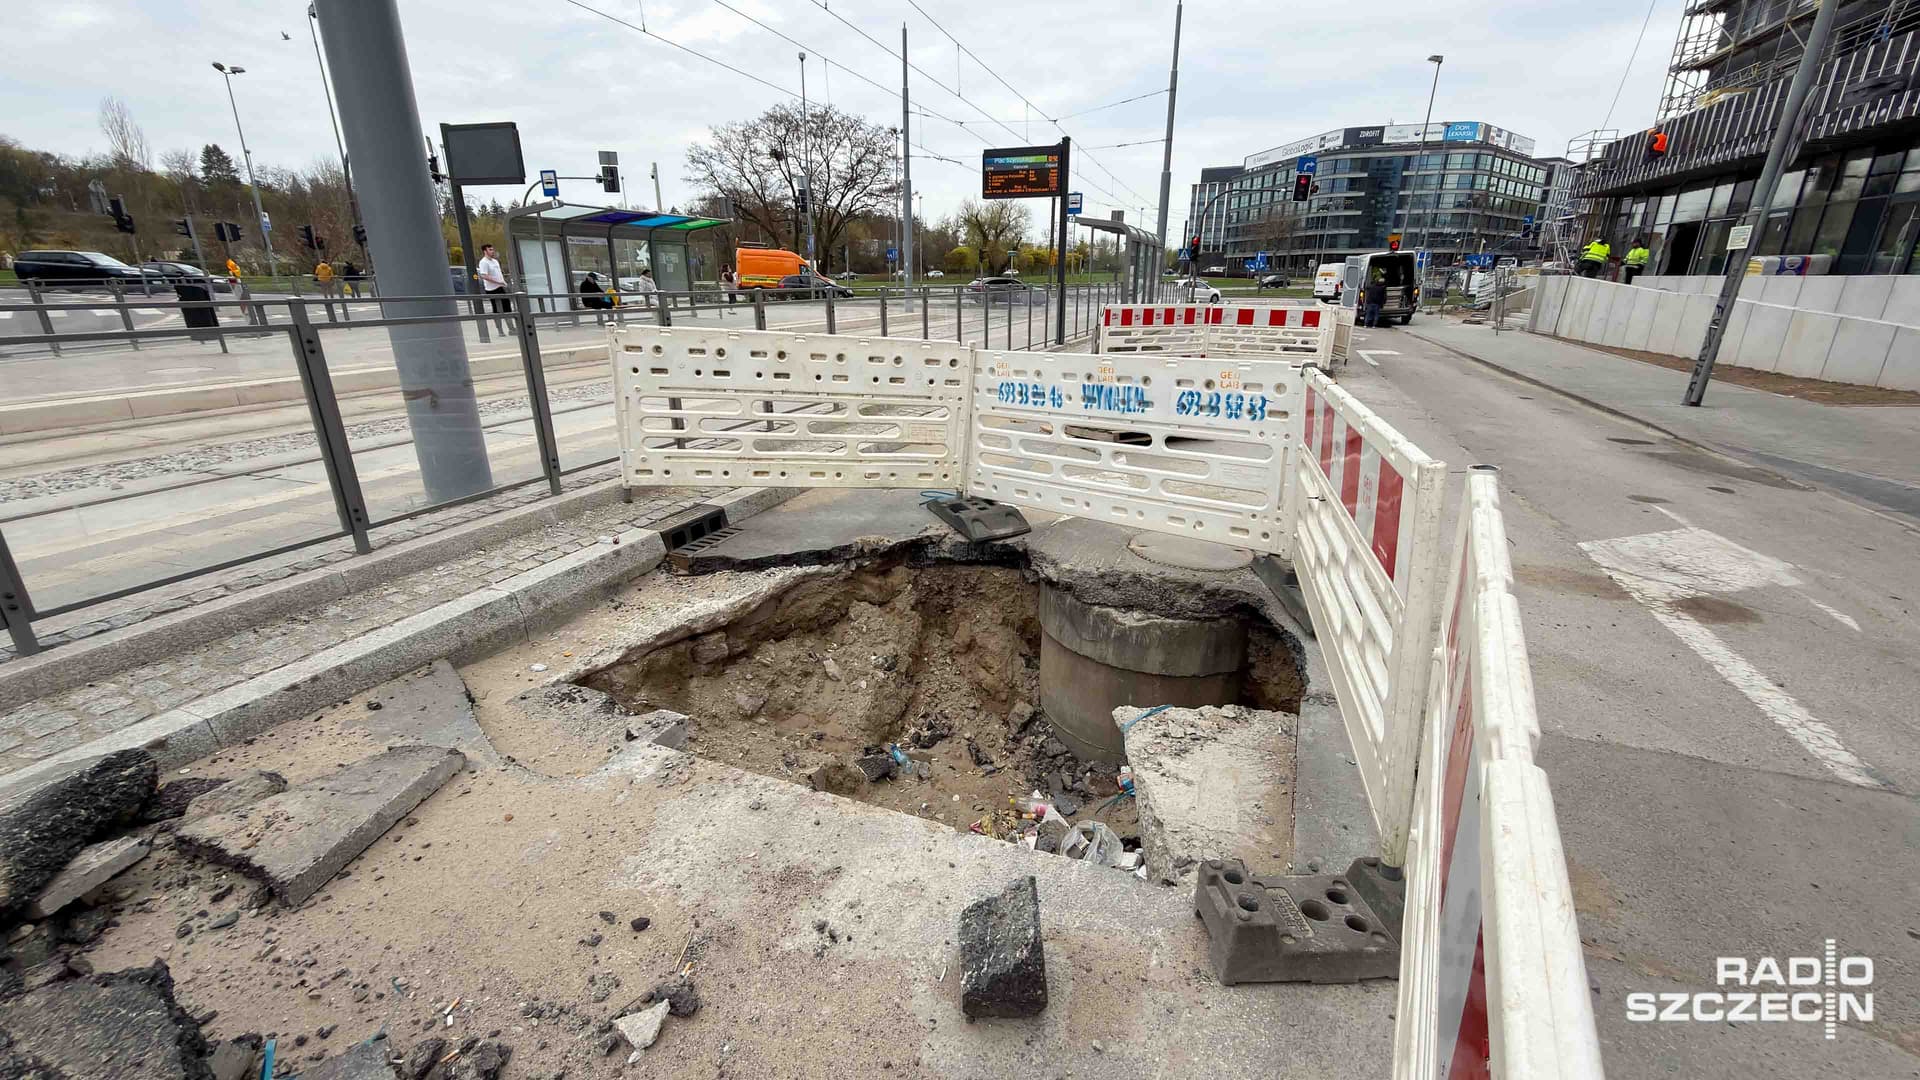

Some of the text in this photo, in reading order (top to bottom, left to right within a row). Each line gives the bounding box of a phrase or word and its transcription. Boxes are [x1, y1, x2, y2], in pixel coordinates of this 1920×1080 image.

[998, 382, 1015, 403] 693
[1081, 383, 1146, 414] WYNAJEM
[1176, 390, 1201, 416] 693
